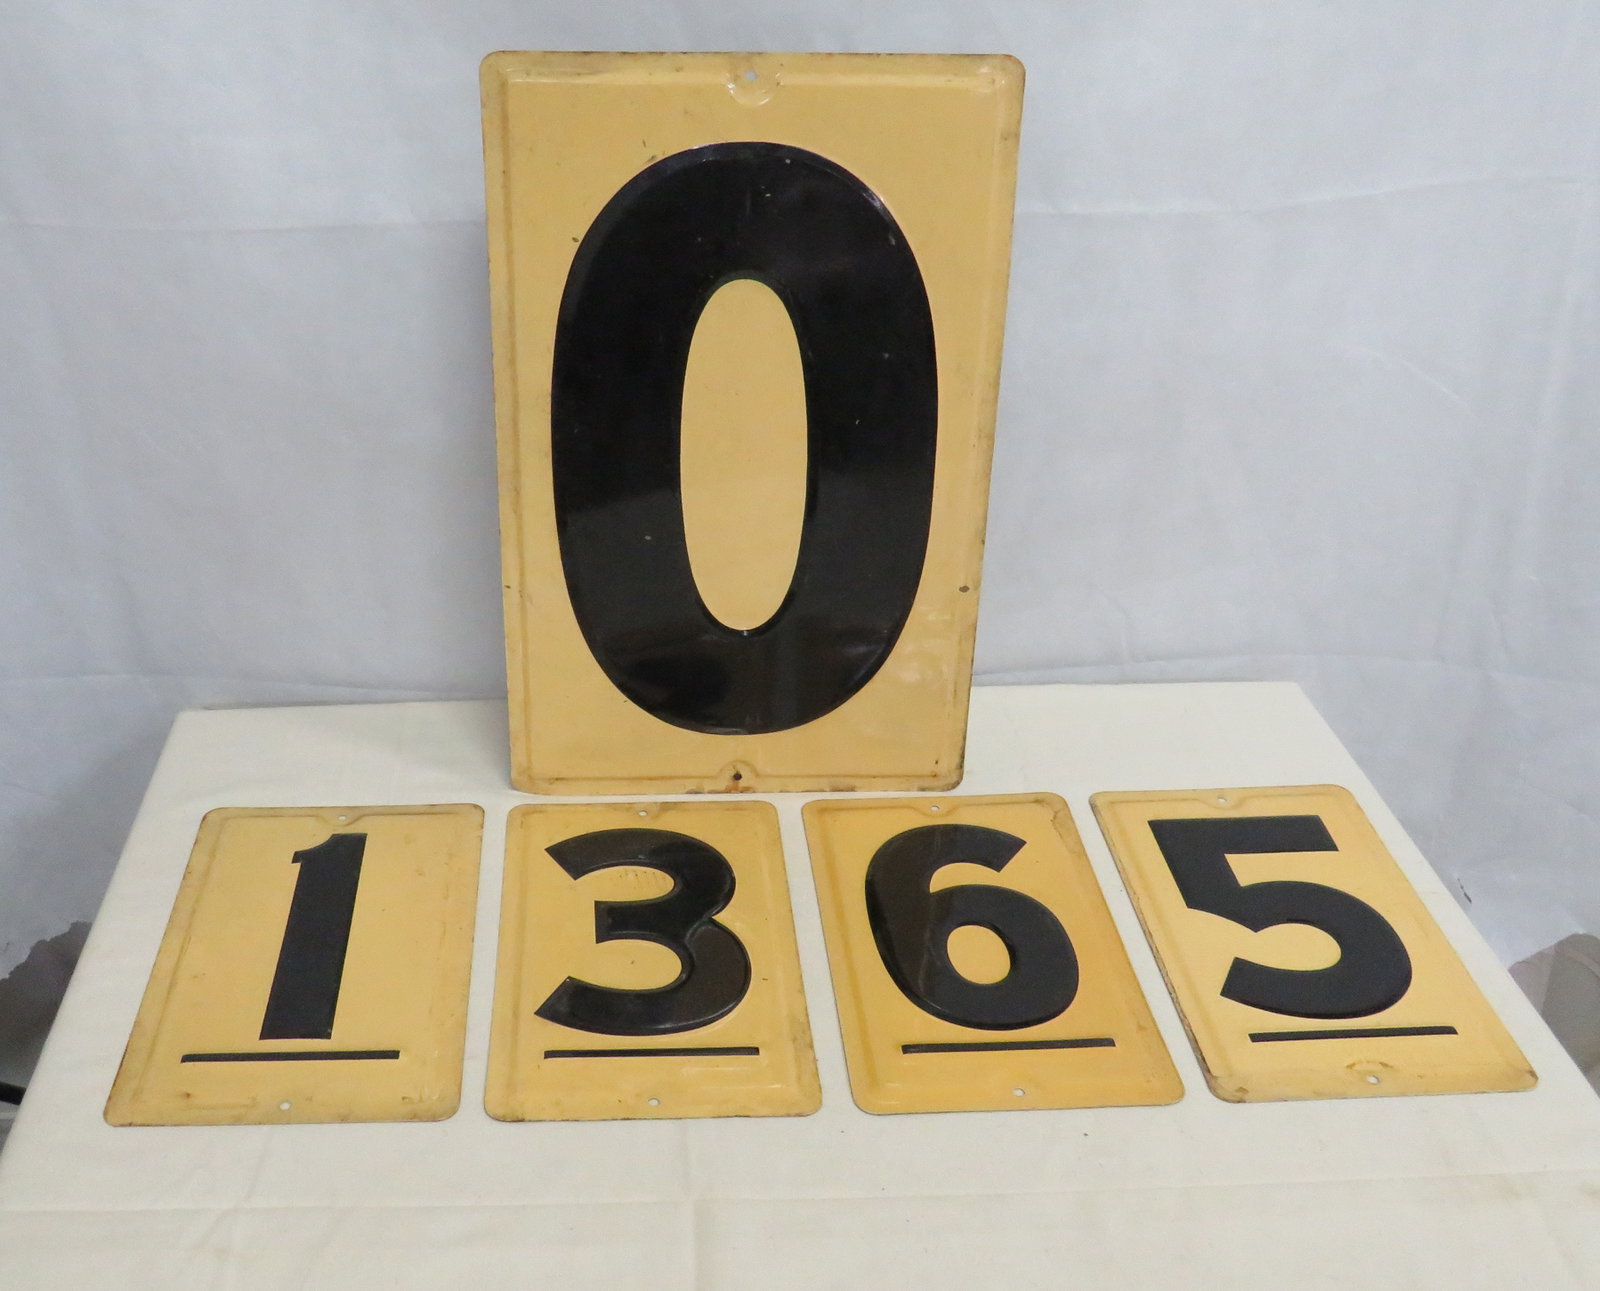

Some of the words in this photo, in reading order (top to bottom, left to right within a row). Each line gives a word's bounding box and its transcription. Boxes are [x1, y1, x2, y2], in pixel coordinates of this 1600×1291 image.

[551, 141, 938, 735] 0
[259, 833, 367, 1040] 1
[534, 828, 752, 1037] 3
[865, 823, 1079, 1031] 6
[1147, 815, 1412, 1020] 5
